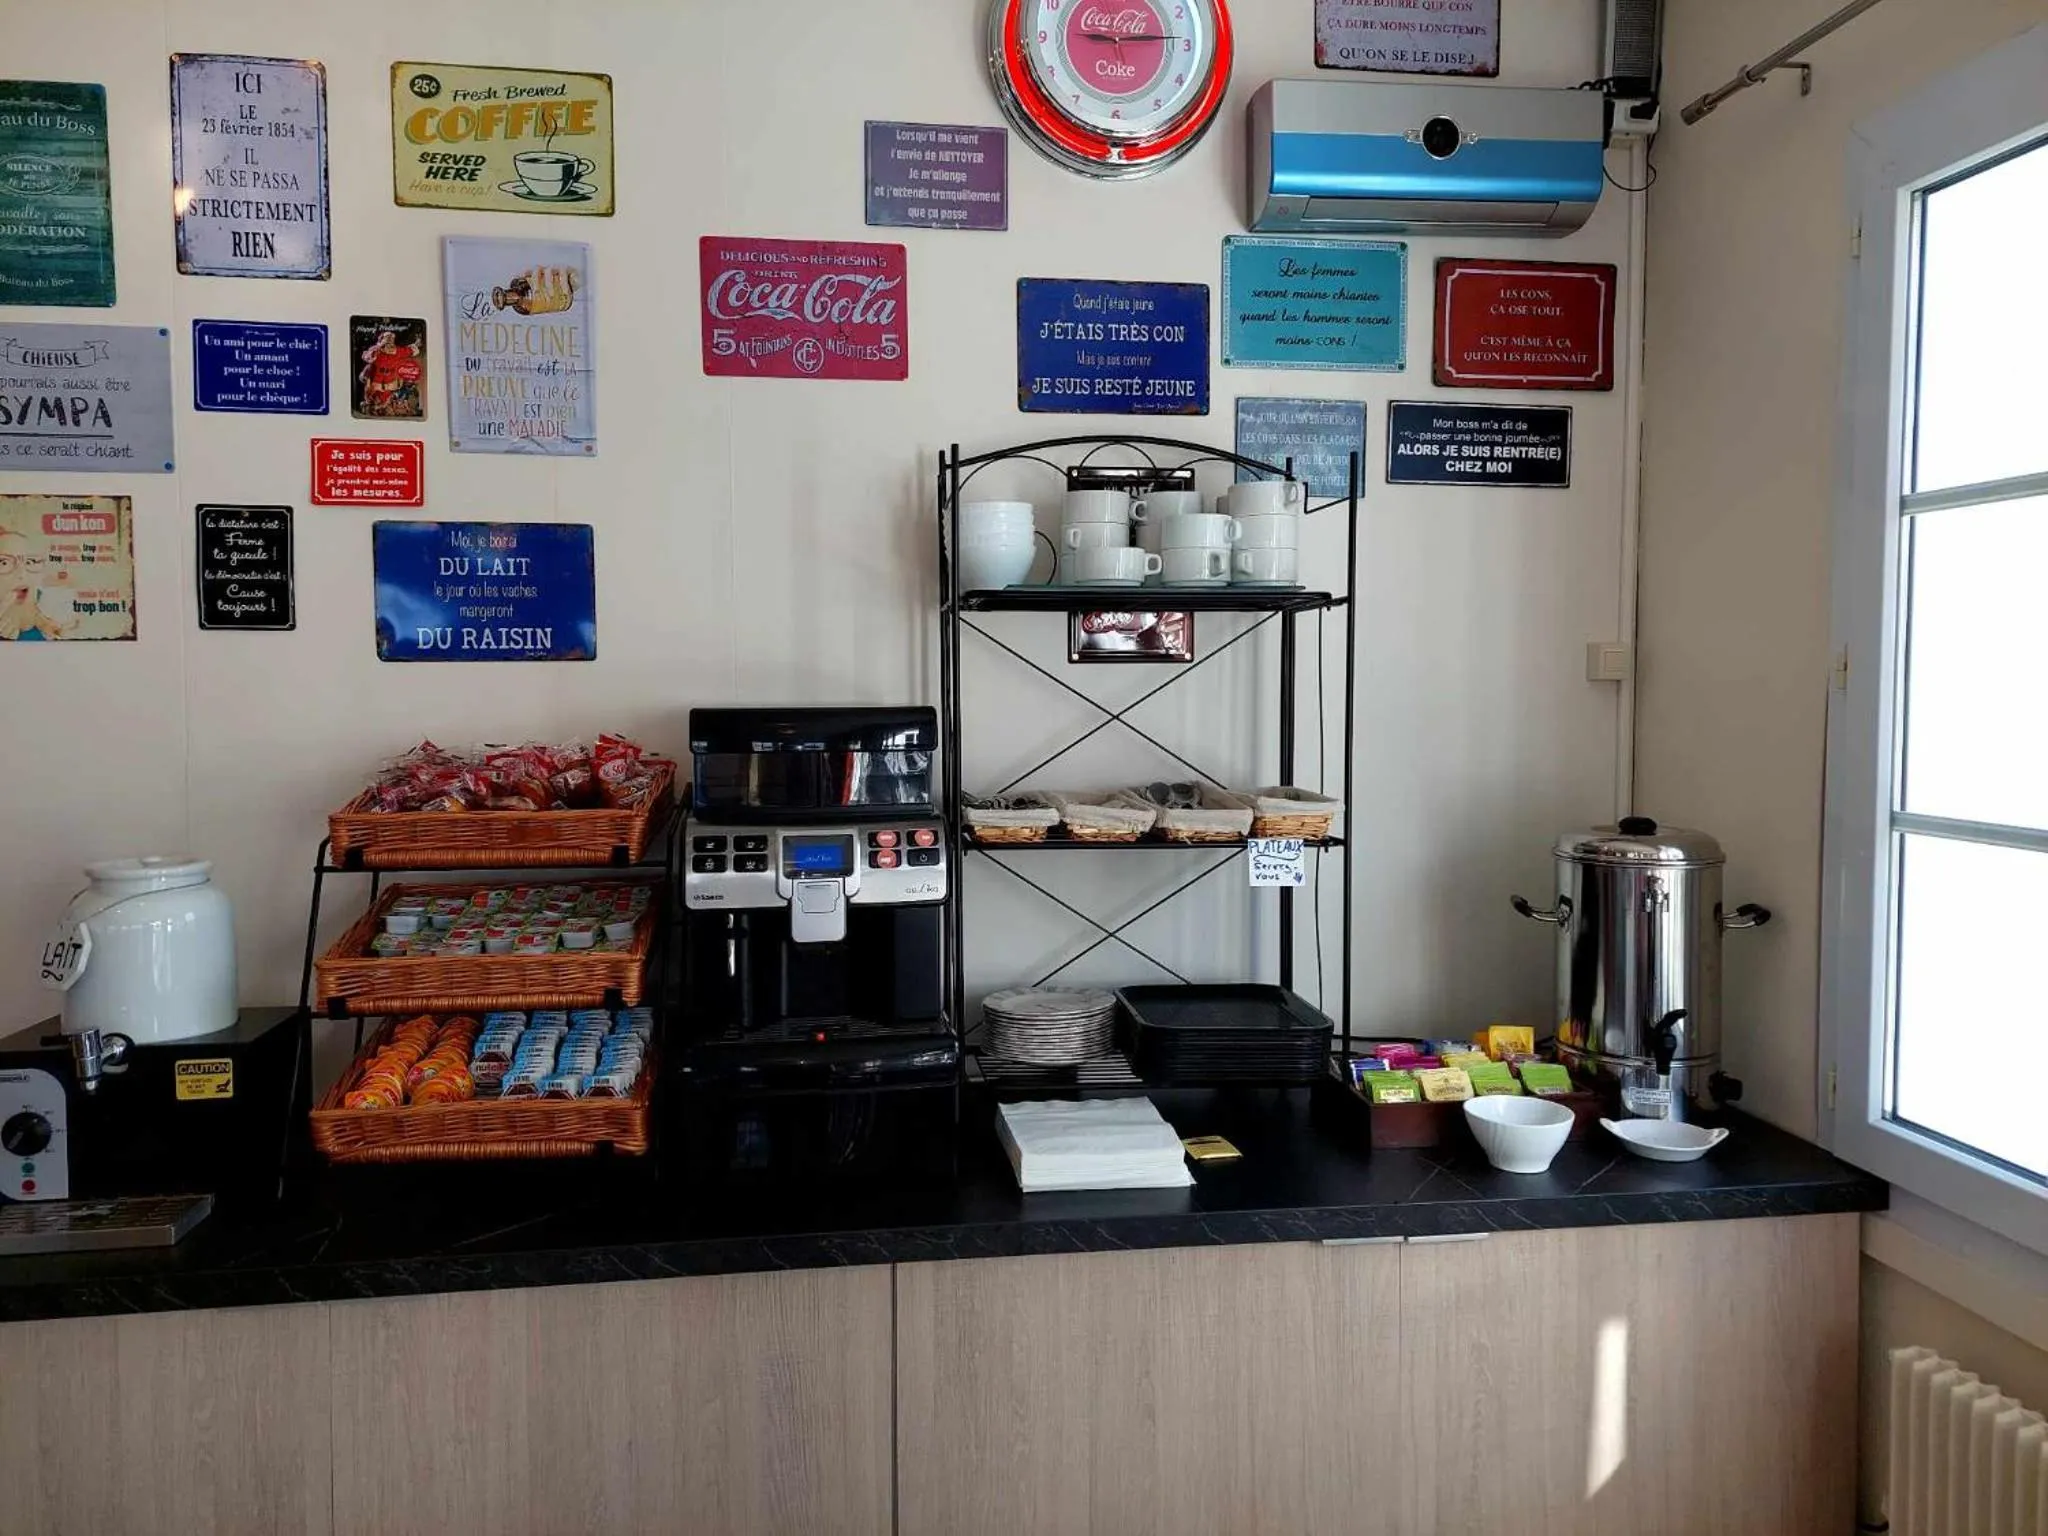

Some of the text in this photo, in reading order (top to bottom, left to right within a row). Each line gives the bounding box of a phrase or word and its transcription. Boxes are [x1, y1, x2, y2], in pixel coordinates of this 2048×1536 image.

[1174, 6, 1183, 19] 2
[1345, 19, 1487, 36] DURE MOINS LONGTEMPS
[1038, 31, 1047, 43] 9
[1184, 40, 1191, 51] 3
[1340, 48, 1429, 62] QU'ON SE LE
[1095, 60, 1136, 77] Coke
[235, 73, 262, 93] ICI
[1175, 74, 1184, 86] 4
[453, 84, 567, 102] Fresh Brewed
[1153, 99, 1162, 111] 5
[240, 105, 256, 120] LE
[1112, 110, 1120, 120] 6
[27, 112, 96, 136] du Boss
[202, 119, 295, 137] 23 février 1854
[404, 100, 598, 145] COFFEE
[245, 149, 258, 165] IL
[418, 152, 486, 165] SERVED
[924, 148, 936, 159] de
[205, 169, 299, 190] NE SE PASSA
[425, 166, 482, 181] HERE
[189, 199, 316, 222] STRICTEMENT
[232, 231, 274, 258] RIEN
[721, 251, 789, 263] DELICIOUS
[810, 255, 887, 268] REFRESHING
[708, 270, 901, 325] Coca-Cola
[1500, 289, 1517, 298] LES
[1073, 294, 1100, 310] Quand
[1303, 309, 1351, 323] hommes
[1509, 306, 1528, 315] OSE
[460, 317, 580, 358] MÉDECINE
[1040, 320, 1184, 342] J'ÉTAIS TRÈS CON
[205, 335, 286, 350] Un ami pour le
[235, 350, 289, 362] Un amant
[1504, 353, 1520, 361] LES
[224, 365, 264, 377] pour le
[466, 357, 481, 371] DU
[240, 378, 285, 389] Un mari
[1032, 377, 1195, 396] JE SUIS RESTÉ JEUNE
[217, 392, 246, 403] pour
[248, 392, 258, 401] le
[524, 404, 542, 416] EST
[479, 420, 568, 438] une MALADIE
[1433, 418, 1528, 430] Mon boss m'a dit de
[1454, 433, 1471, 441] une
[1474, 432, 1502, 442] bonne
[331, 450, 403, 464] Je suis pour
[1398, 444, 1561, 461] ALORS JE SUIS RENTRÉ(E)
[1446, 461, 1512, 473] CHEZ MOI
[331, 487, 348, 496] les
[439, 557, 531, 576] DU LAIT
[73, 600, 119, 616] trop bon
[417, 627, 552, 649] DU RAISIN
[1249, 840, 1304, 854] PLATEAUX
[179, 1063, 230, 1074] CAUTION
